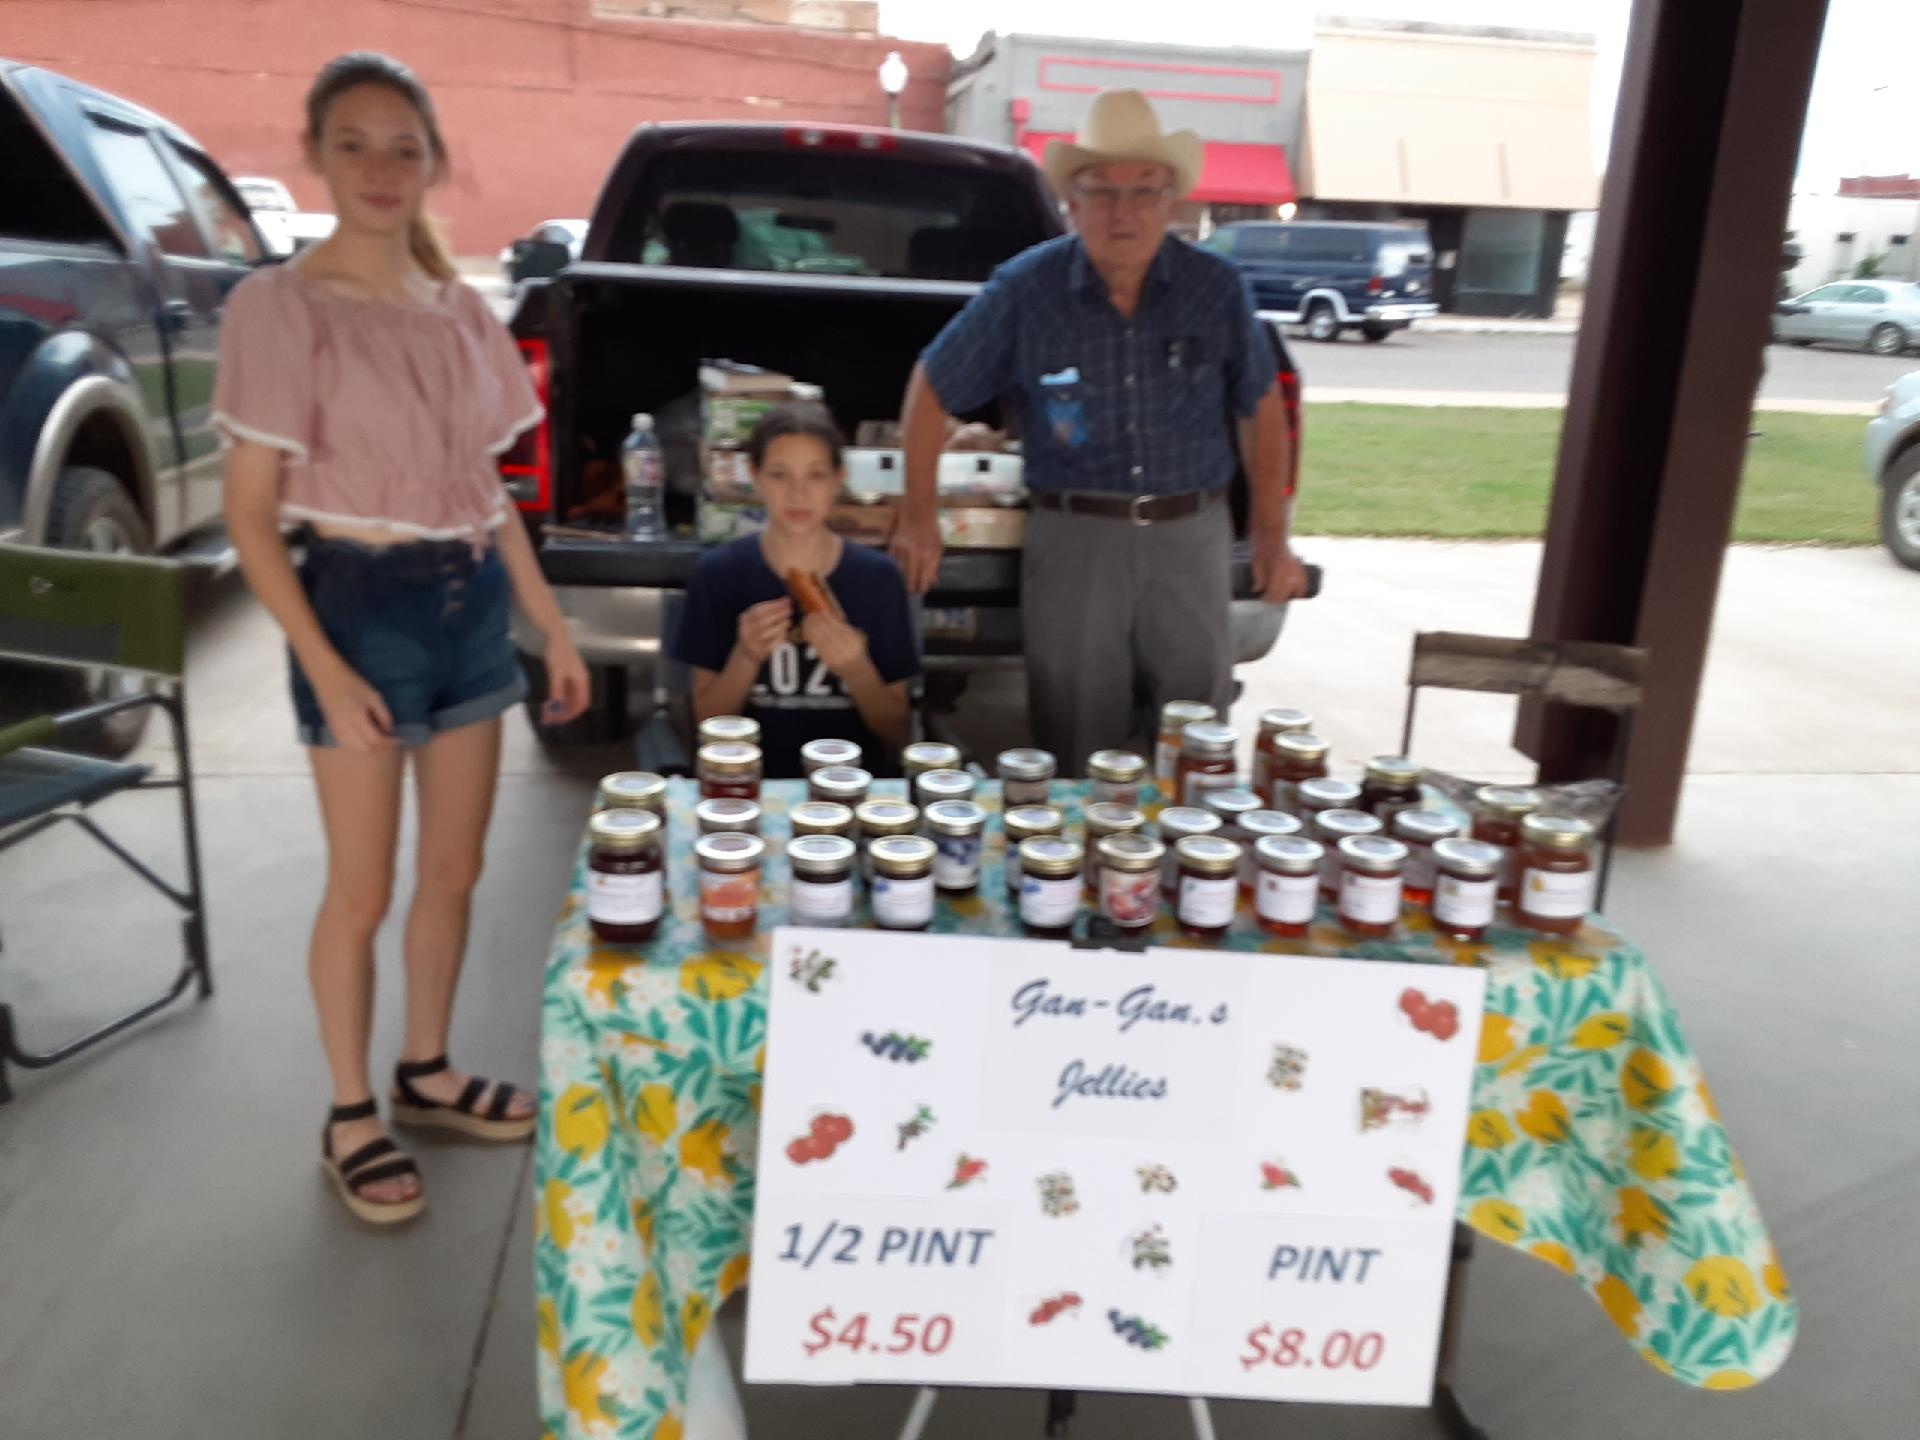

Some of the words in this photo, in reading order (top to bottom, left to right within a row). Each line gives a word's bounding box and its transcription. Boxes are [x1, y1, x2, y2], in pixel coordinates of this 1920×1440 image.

[1050, 1058, 1168, 1109] Jellies
[777, 1220, 864, 1270] 1/2
[876, 1226, 995, 1267] PINT
[1267, 1244, 1384, 1284] PINT
[802, 1306, 955, 1358] $4.50
[1239, 1322, 1385, 1372] $8.00
